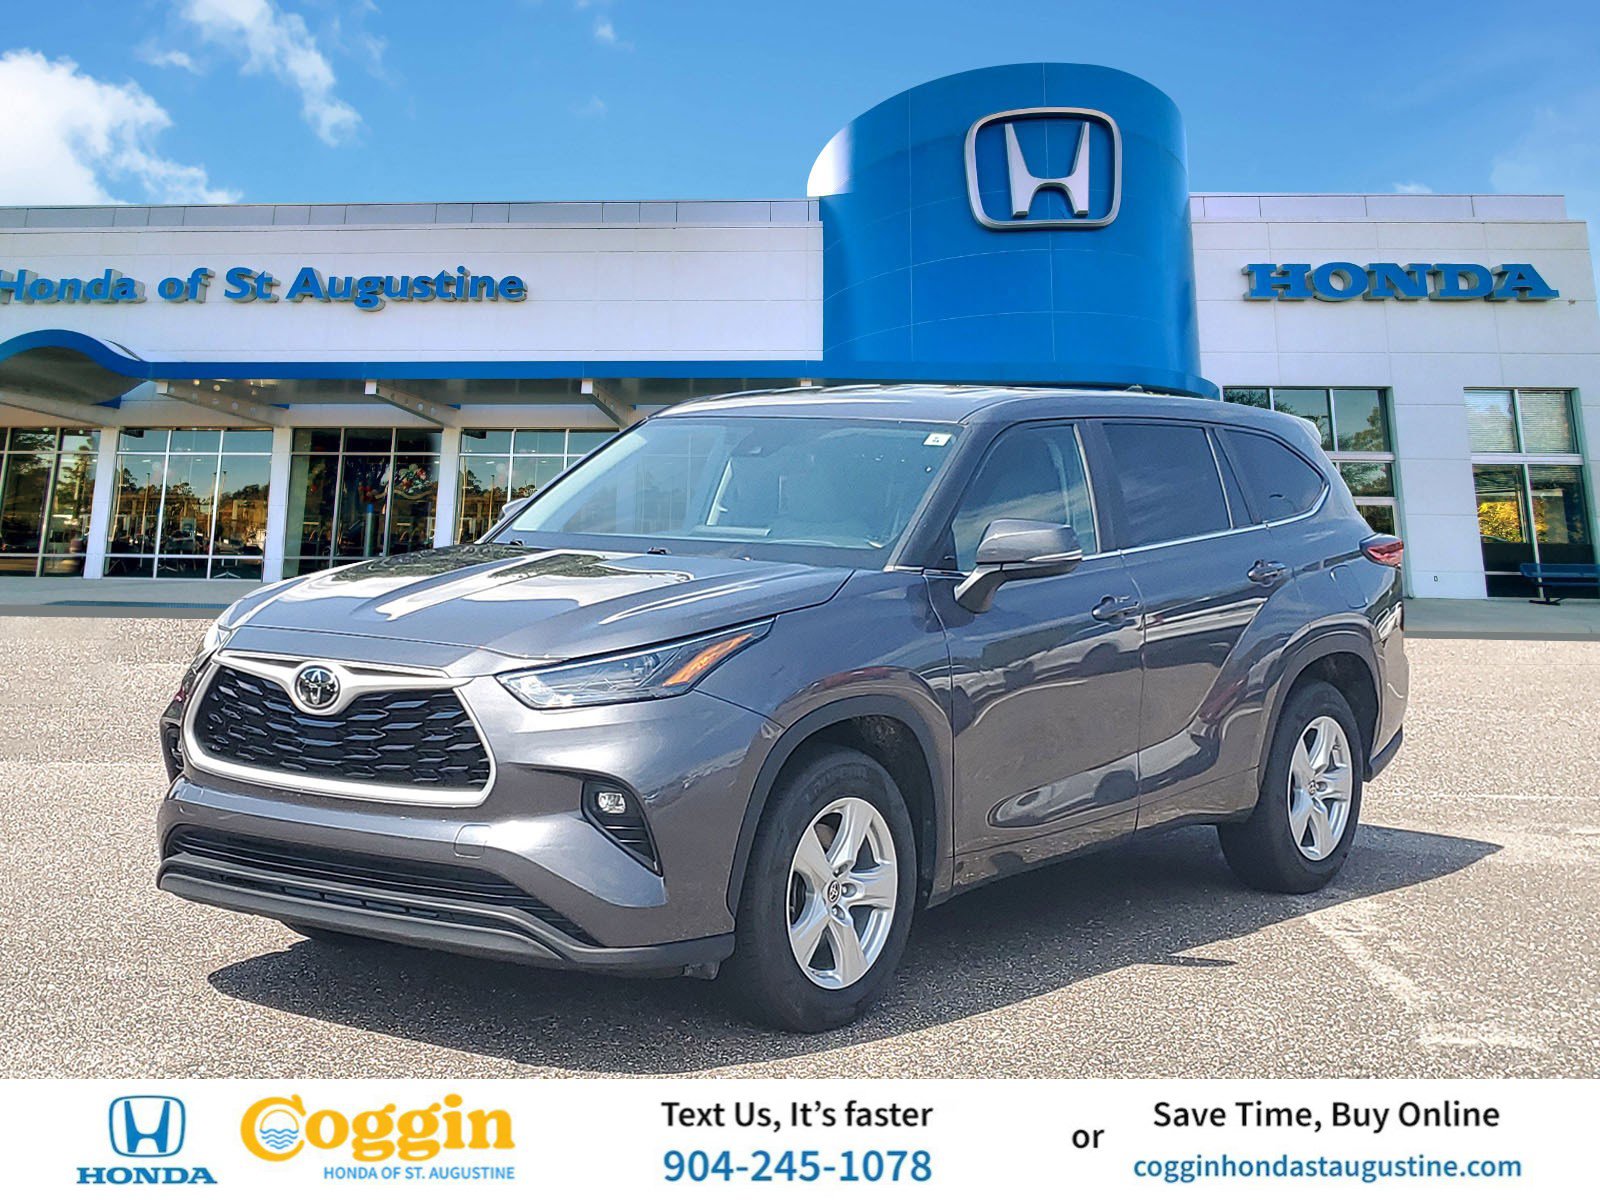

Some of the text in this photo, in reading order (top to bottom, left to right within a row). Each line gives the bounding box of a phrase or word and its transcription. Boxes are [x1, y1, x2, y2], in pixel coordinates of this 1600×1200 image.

[0, 265, 526, 311] Honda of St Augustine
[1242, 261, 1560, 302] HONDA
